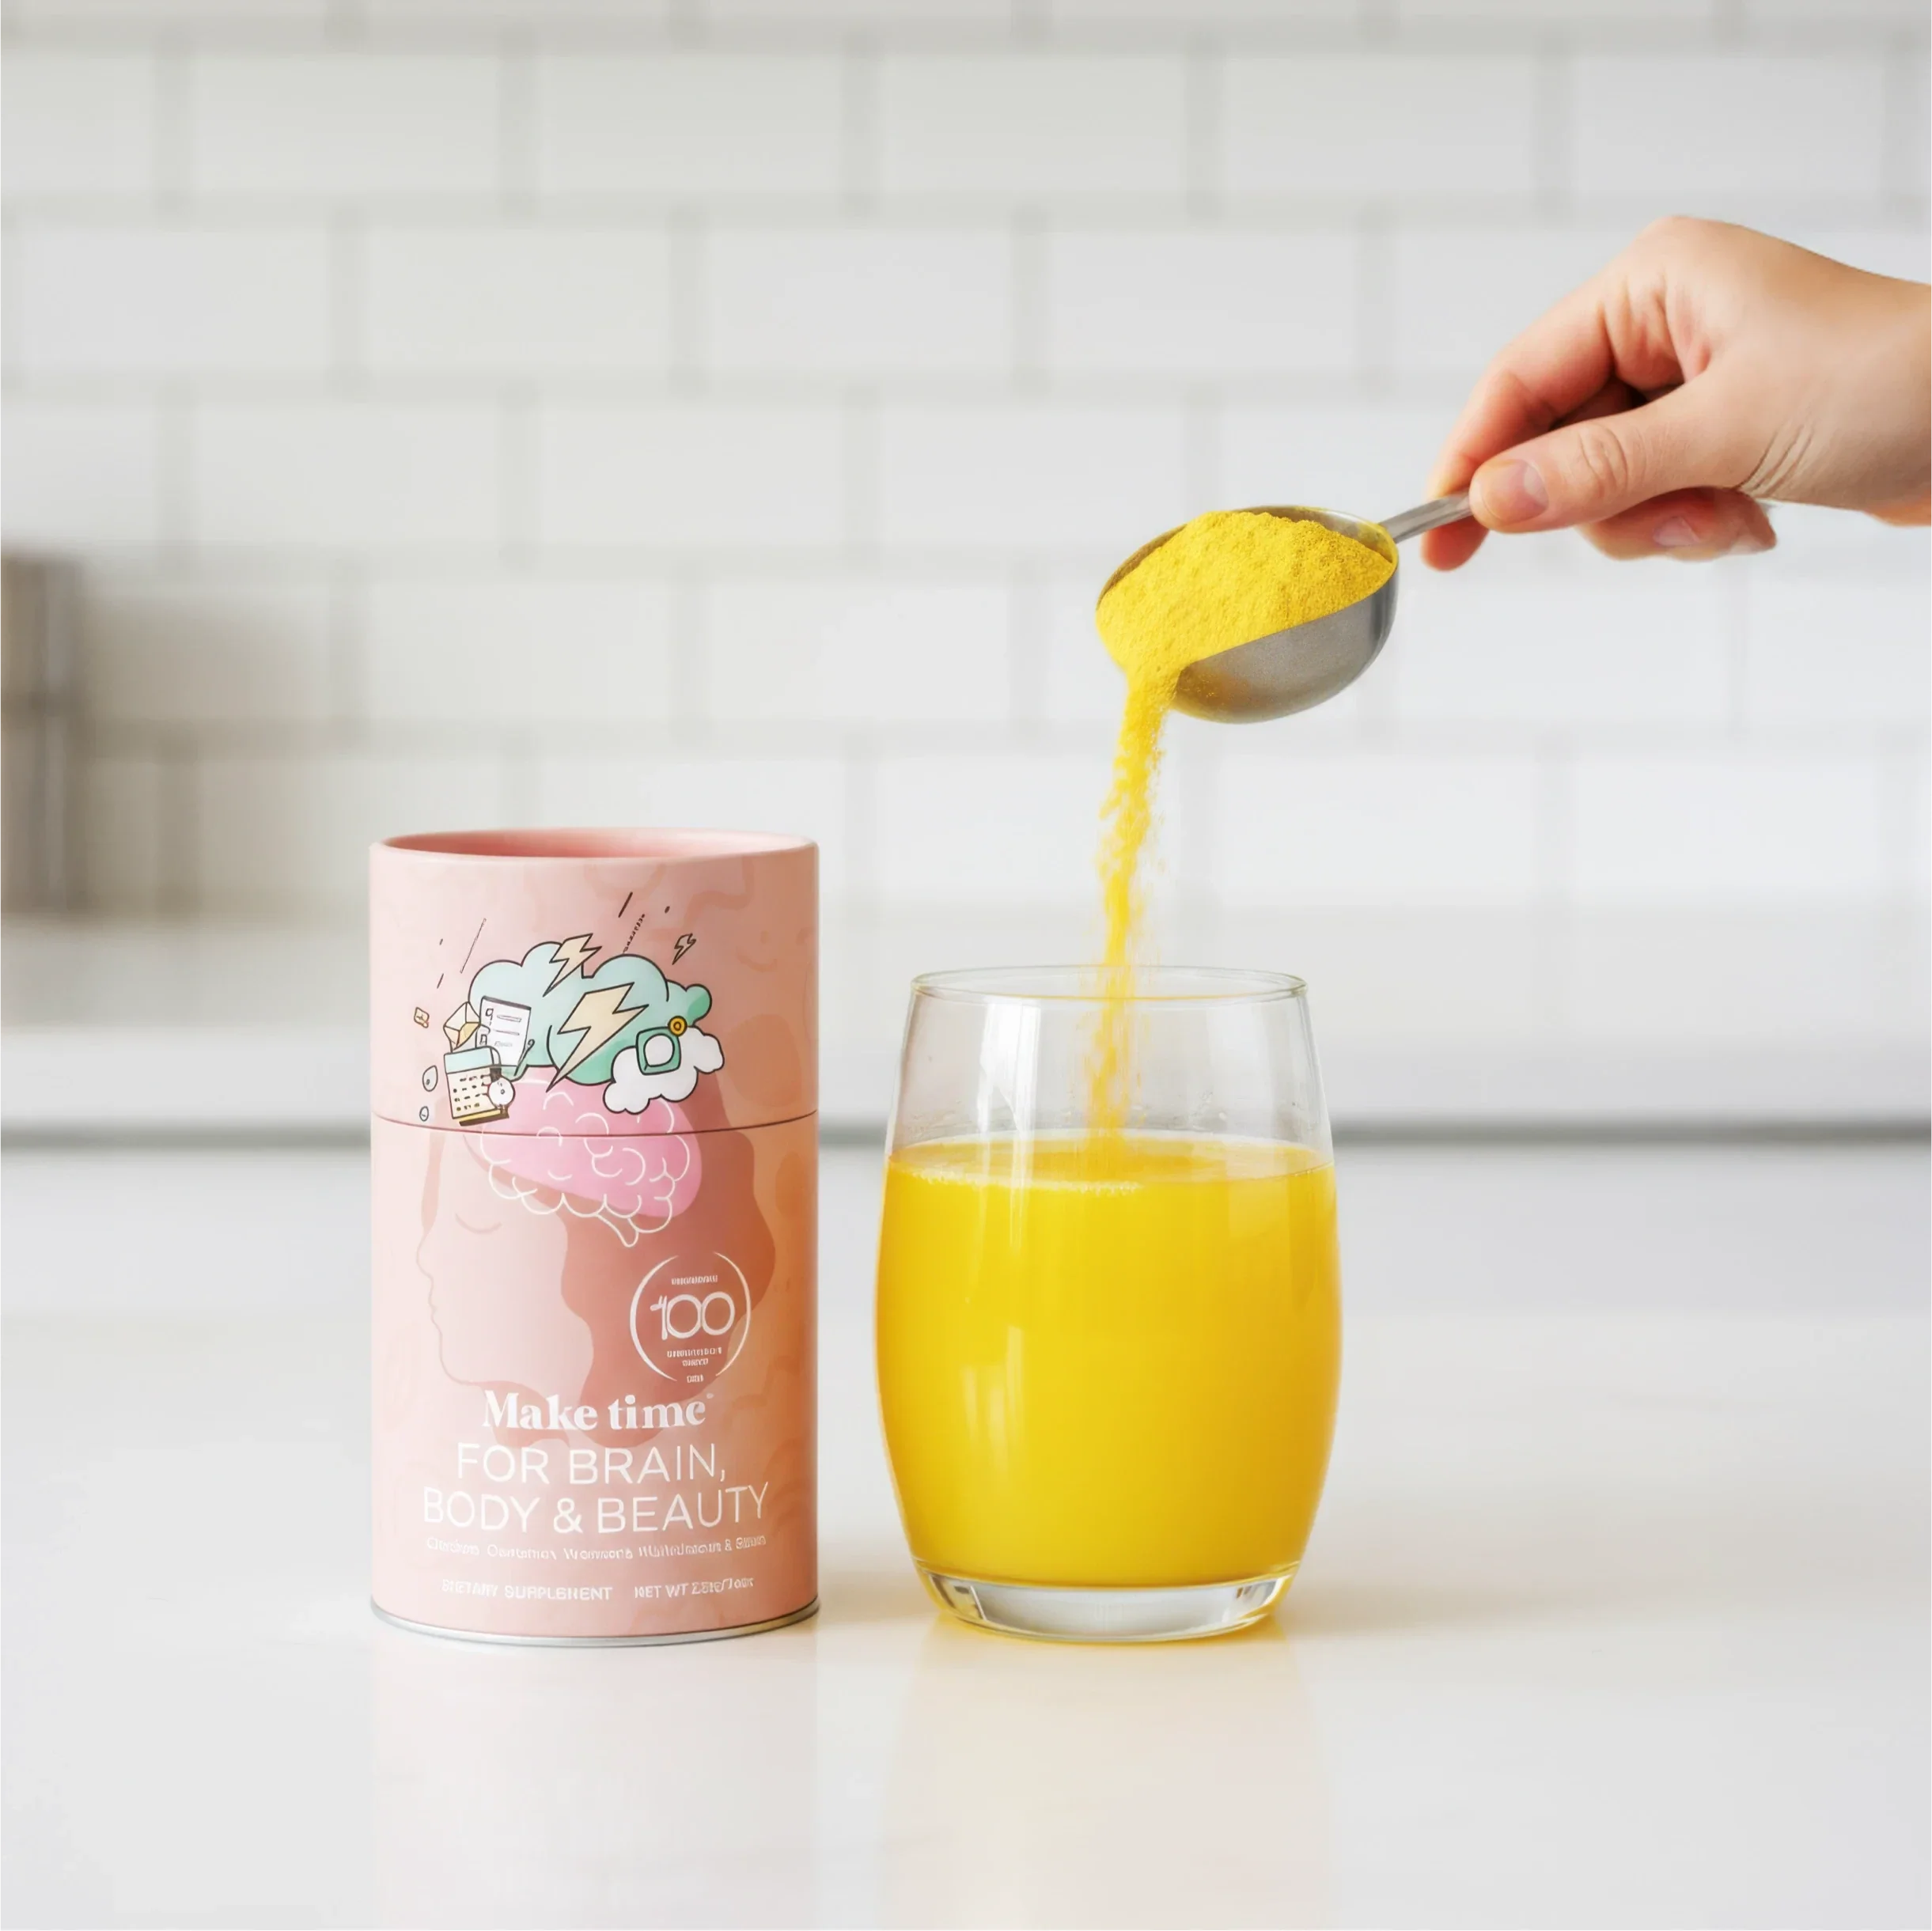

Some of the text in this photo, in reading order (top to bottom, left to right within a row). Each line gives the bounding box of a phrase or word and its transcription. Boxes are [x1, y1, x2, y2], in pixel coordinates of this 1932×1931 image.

[482, 1390, 706, 1430] Make time
[457, 1442, 725, 1484] FOR BRAIN,
[423, 1482, 768, 1533] BODY & BEAUTY
